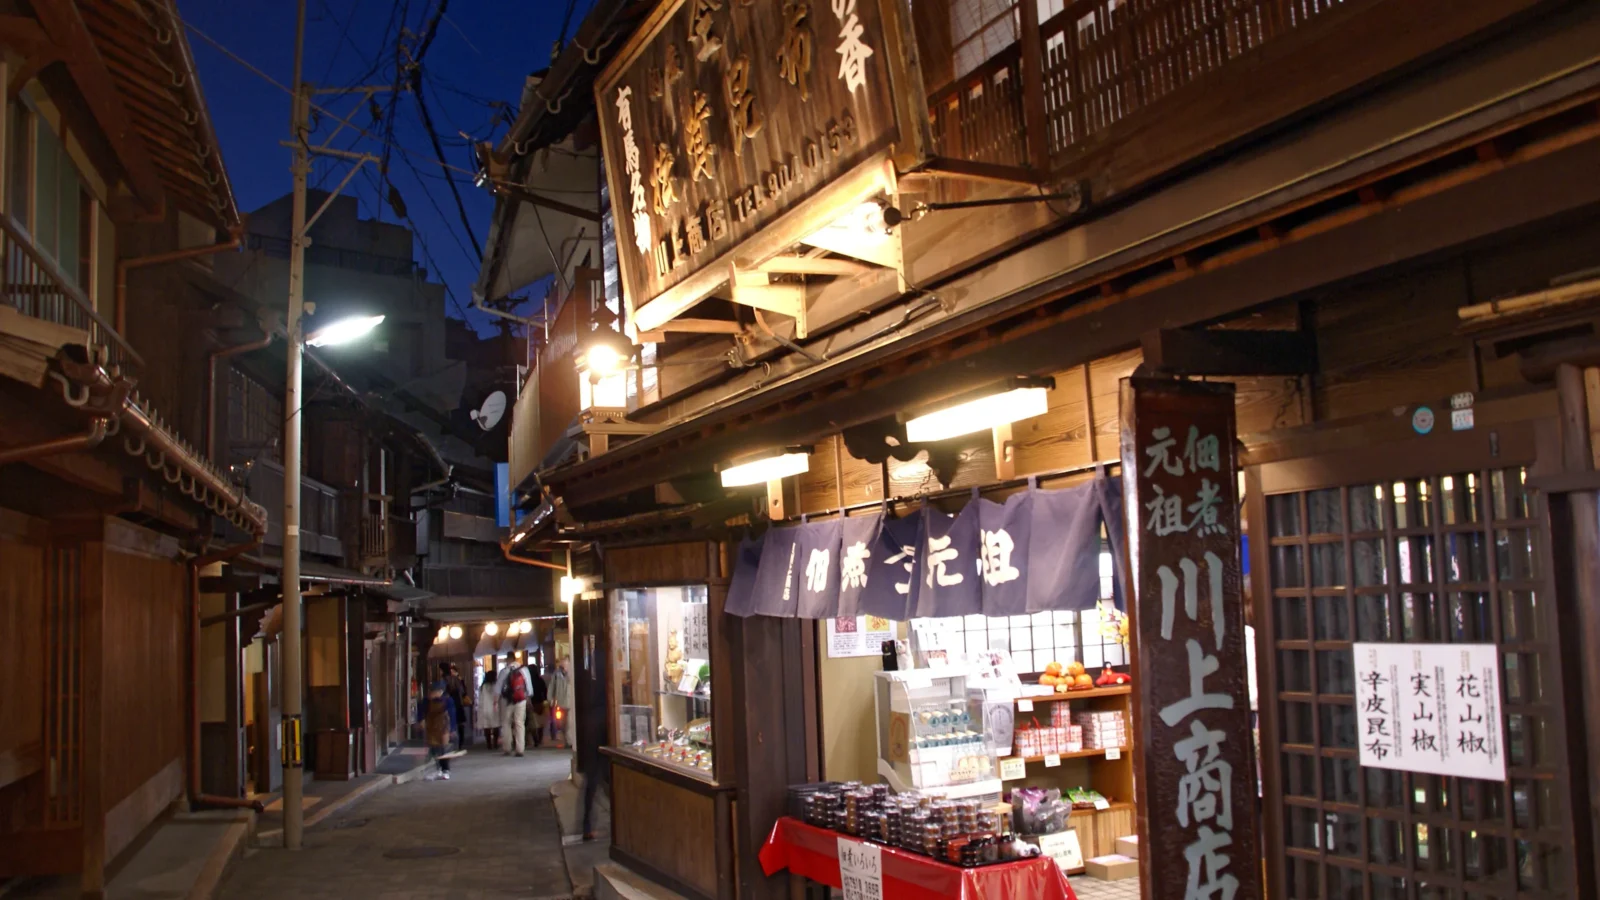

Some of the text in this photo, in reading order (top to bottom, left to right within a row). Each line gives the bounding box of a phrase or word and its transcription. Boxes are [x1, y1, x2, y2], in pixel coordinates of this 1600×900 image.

[654, 199, 728, 278] 川上商店
[734, 185, 768, 222] TEL
[768, 155, 803, 201] 904
[1143, 426, 1188, 537] 元祖
[1183, 424, 1227, 538] 佃煮
[1362, 670, 1392, 761] 辛皮昆布
[1410, 672, 1438, 752] 実山椒
[1456, 674, 1488, 754] 花山椒
